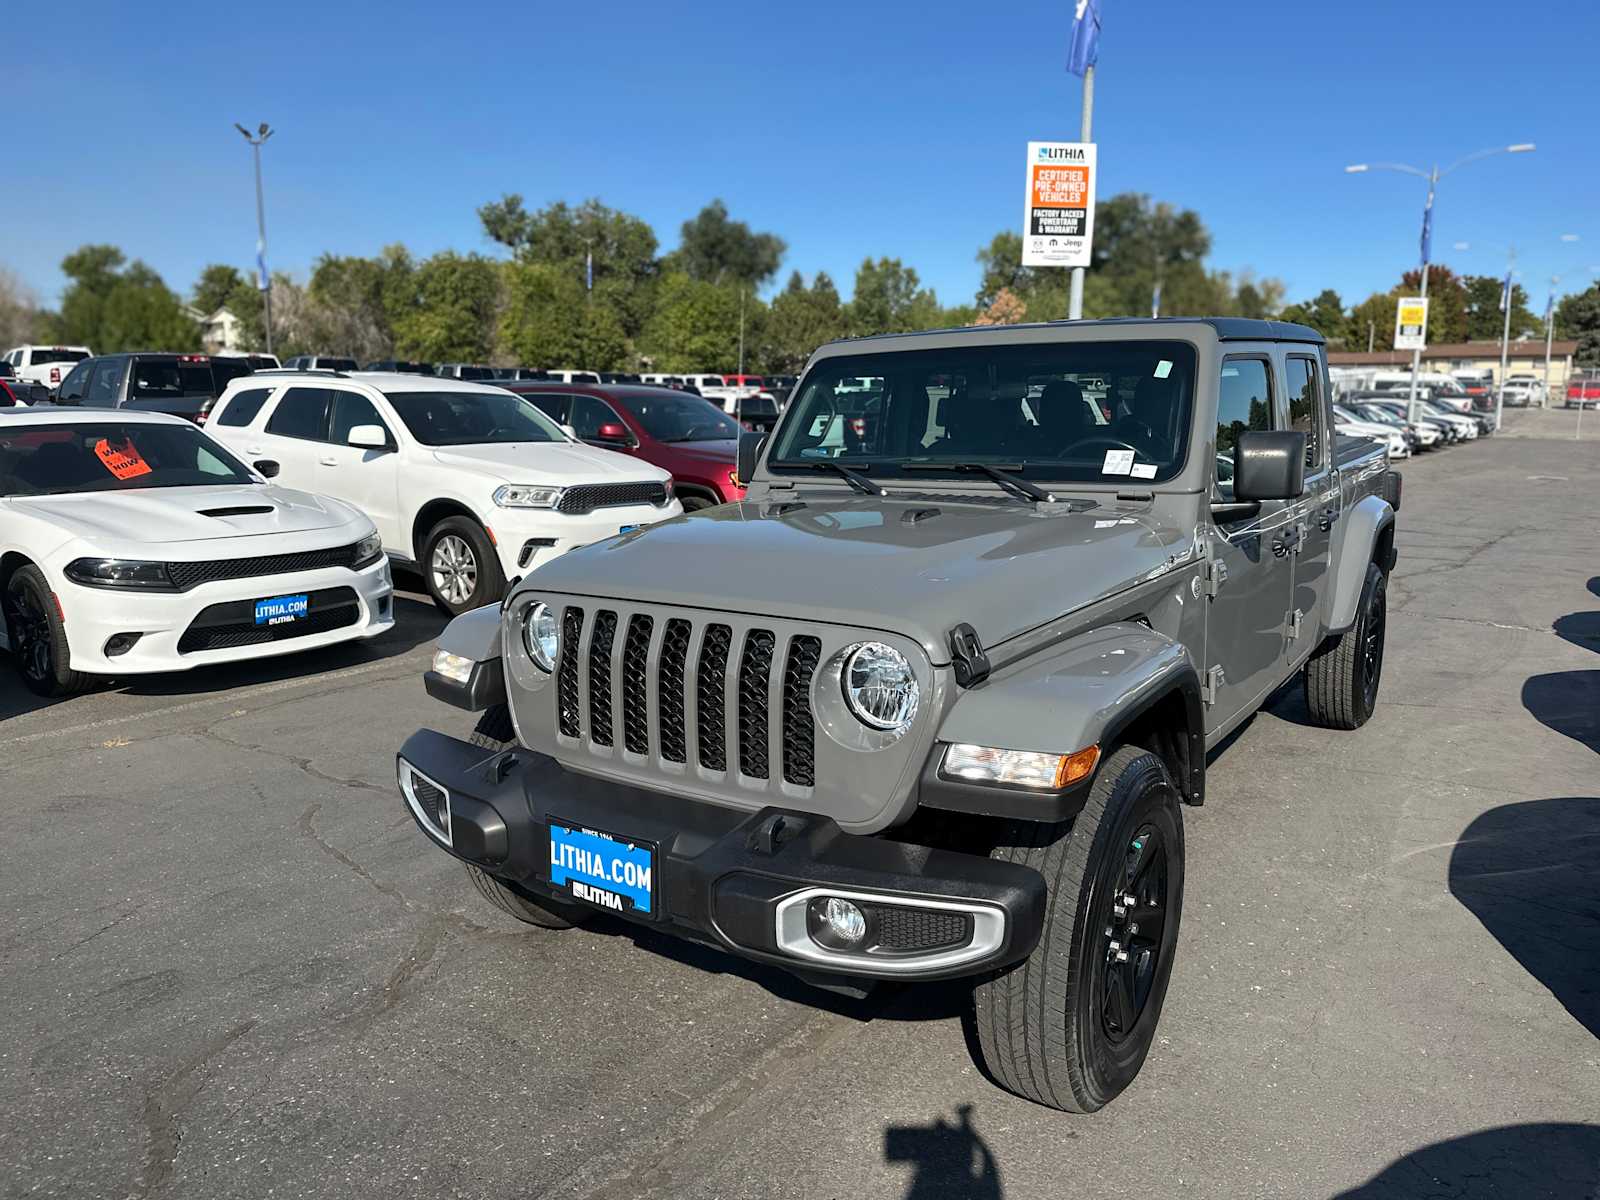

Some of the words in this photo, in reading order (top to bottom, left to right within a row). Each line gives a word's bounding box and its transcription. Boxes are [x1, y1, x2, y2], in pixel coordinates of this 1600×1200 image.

[1048, 148, 1084, 159] LITHIA
[1039, 169, 1084, 181] CERTIFIED
[1034, 180, 1086, 192] PRE-OWNED
[1039, 191, 1081, 203] VEHICLES
[1033, 208, 1060, 218] FACTORY
[1060, 209, 1085, 218] BACKED
[1038, 217, 1078, 226] POWERTRAIN
[1044, 225, 1078, 234] WARRANTY
[1063, 239, 1082, 248] Jeep
[255, 599, 308, 618] LITHIA.COM
[275, 614, 296, 624] LITHIA
[581, 827, 599, 838] SINCE
[599, 832, 614, 842] 1946
[550, 840, 652, 893] LITHIA.COM
[583, 885, 624, 911] LITHIA
